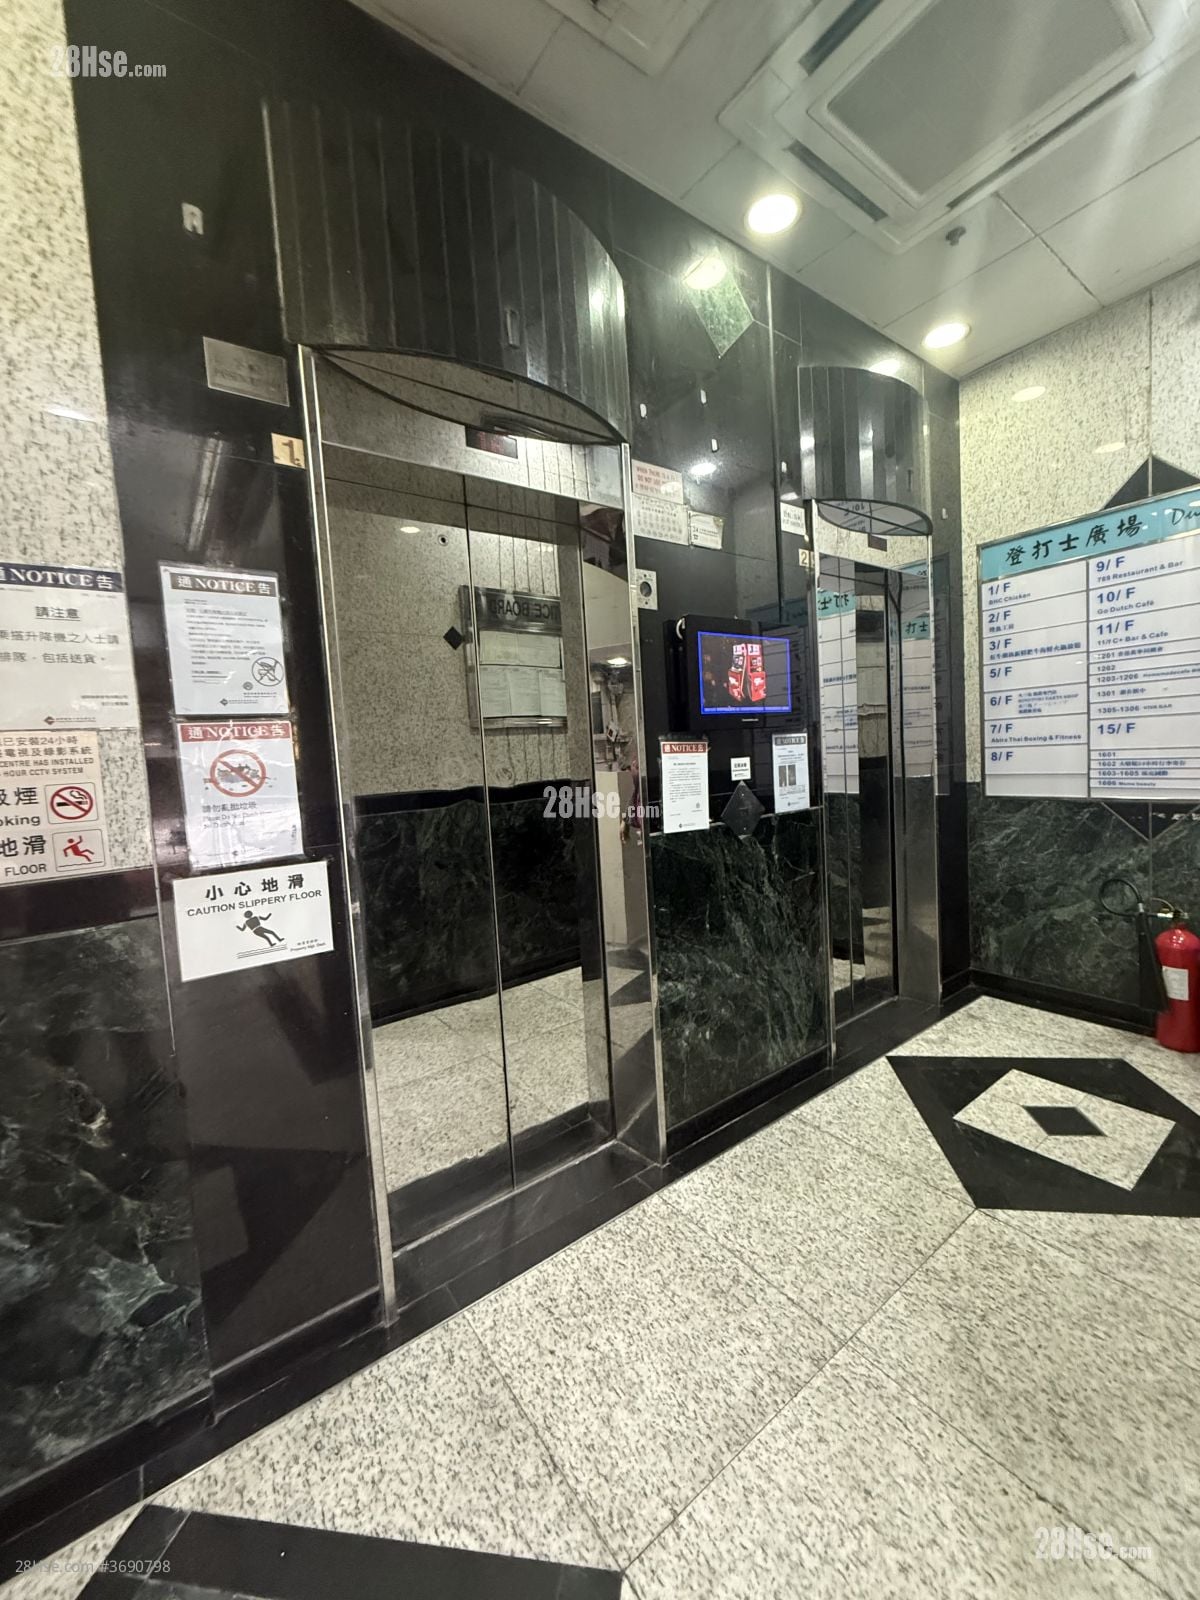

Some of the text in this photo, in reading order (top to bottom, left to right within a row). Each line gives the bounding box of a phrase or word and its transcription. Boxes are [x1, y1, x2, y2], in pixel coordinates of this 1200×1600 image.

[1006, 514, 1143, 566] 登打士廣場
[801, 553, 810, 568] 2
[1112, 566, 1157, 578] Restaurant
[9, 568, 94, 587] NOTICE
[96, 575, 114, 590] 告
[196, 578, 256, 592] NOTICE
[257, 582, 271, 595] 告
[35, 606, 80, 620] 請注意
[207, 726, 269, 738] NOTICE
[0, 736, 77, 746] 已安裝24小時
[0, 747, 92, 757] 電視及錄影系統
[671, 744, 698, 752] NOTICE
[52, 757, 94, 765] INSTALLED
[52, 767, 83, 775] SYSTEM
[5, 864, 47, 876] FLOOR
[205, 874, 304, 900] 小心地滑
[187, 889, 322, 917] CAUTION SLIPPERY FLOOR
